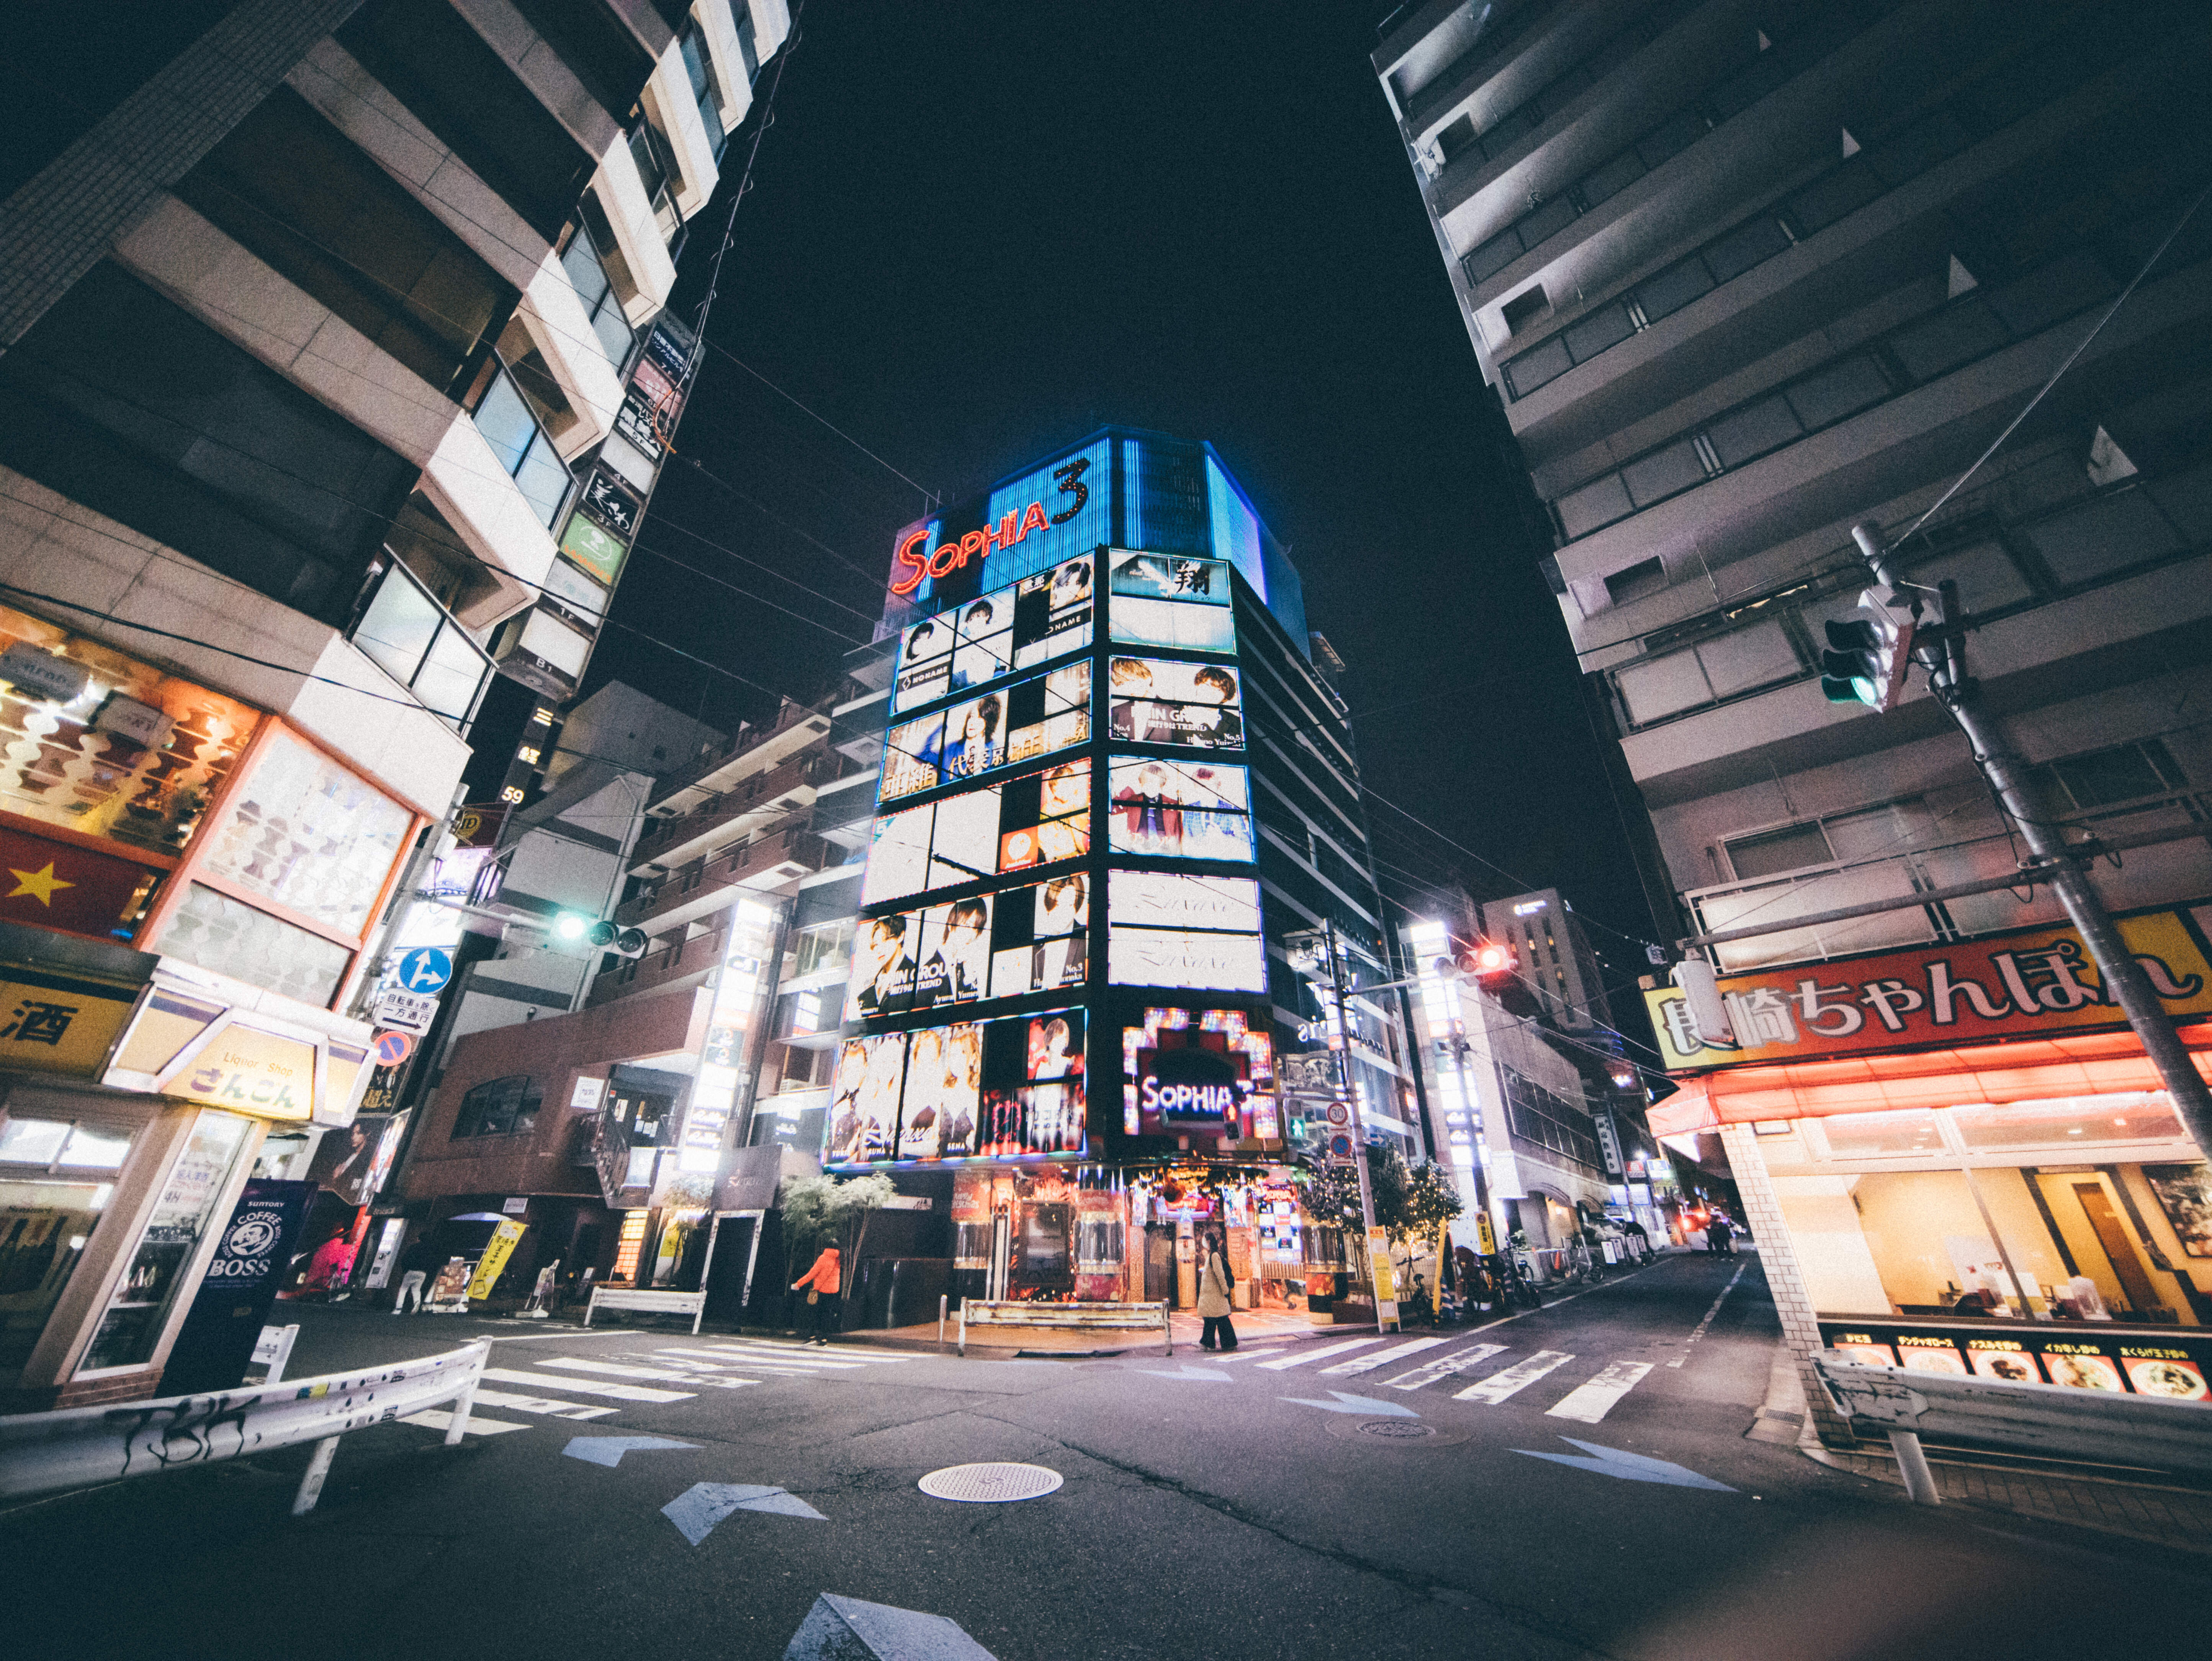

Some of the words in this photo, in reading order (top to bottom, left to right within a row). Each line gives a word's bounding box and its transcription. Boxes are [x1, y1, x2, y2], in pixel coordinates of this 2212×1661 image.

[632, 432, 645, 445] 5F
[615, 473, 628, 484] 4F
[1051, 457, 1091, 524] 3
[597, 514, 612, 527] 3F
[1175, 563, 1210, 595] 翔
[560, 606, 575, 621] 1F
[536, 657, 552, 673] B1
[1224, 733, 1240, 741] No.5
[1066, 962, 1083, 974] No.3
[387, 994, 437, 1012] 自転車を除く
[1660, 939, 2203, 1056] 長崎ちゃんぽん
[1, 999, 79, 1046] 酒
[384, 1006, 430, 1023] 一方通行
[224, 1052, 259, 1070] Liquor
[267, 1062, 293, 1077] Shop
[1141, 1076, 1234, 1113] SOPHIA
[1331, 1109, 1344, 1119] 30
[237, 1211, 282, 1226] COFFEE
[206, 1259, 271, 1277] BOSS
